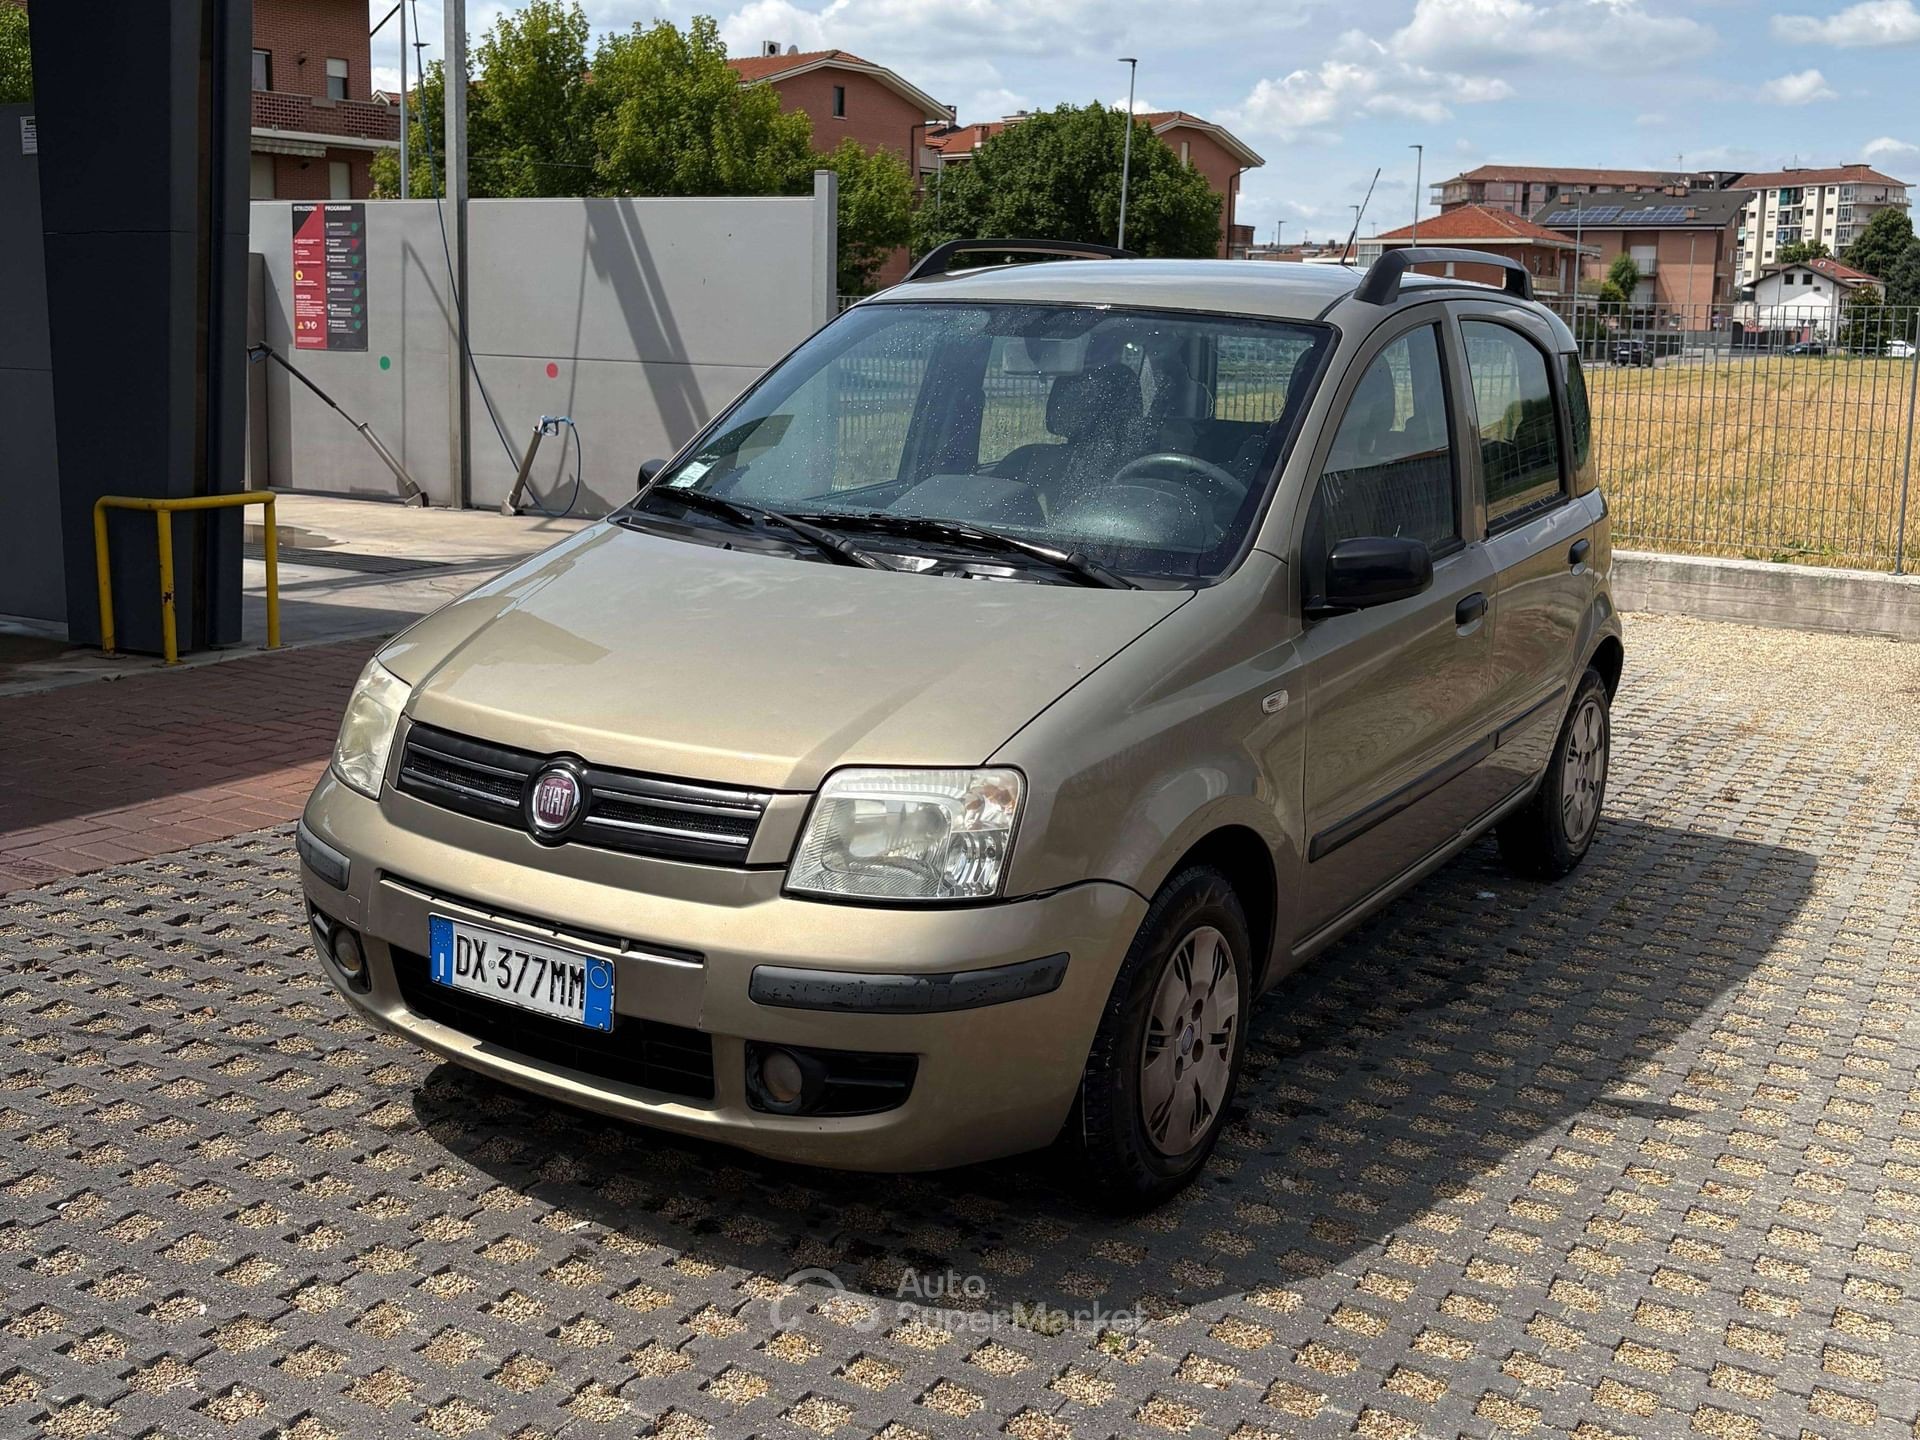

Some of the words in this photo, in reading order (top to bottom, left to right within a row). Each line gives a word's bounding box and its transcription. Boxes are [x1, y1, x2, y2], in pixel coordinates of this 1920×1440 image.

[540, 785, 571, 816] FIAT
[456, 933, 488, 983] DX
[496, 946, 585, 1010] 377MM
